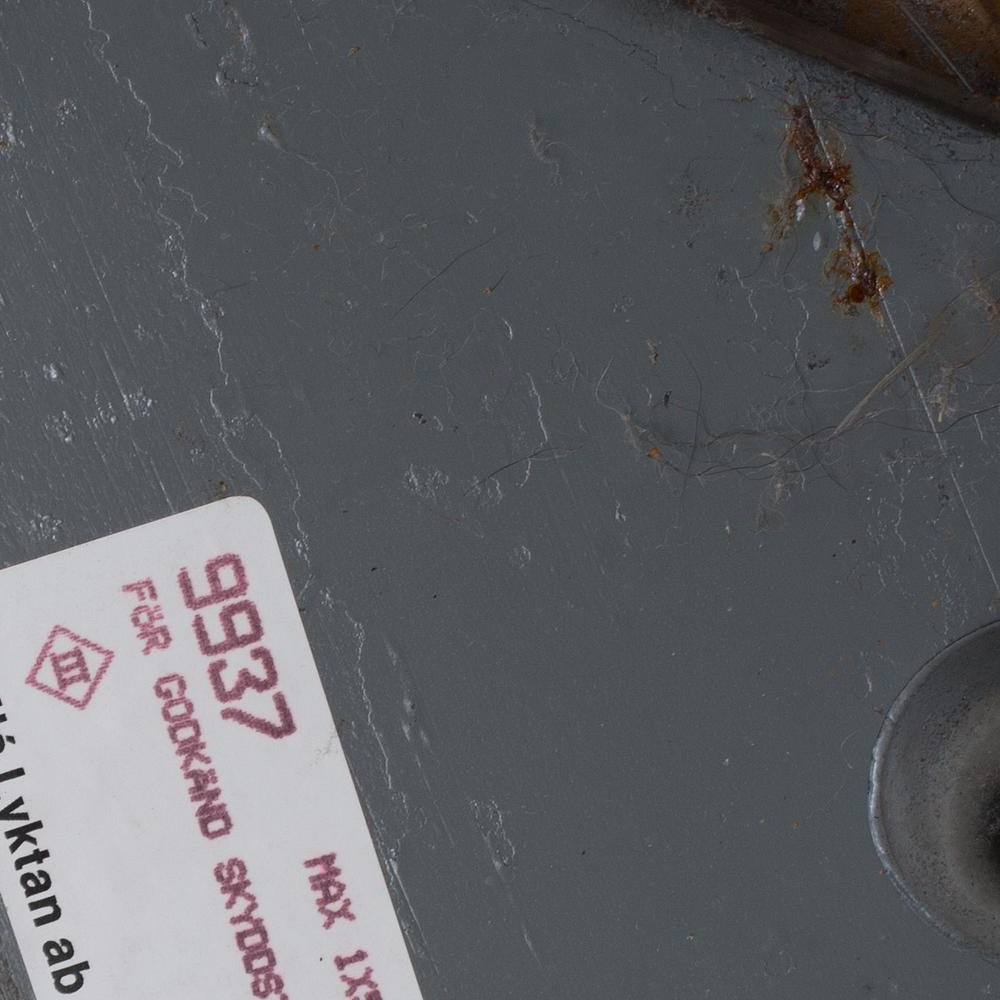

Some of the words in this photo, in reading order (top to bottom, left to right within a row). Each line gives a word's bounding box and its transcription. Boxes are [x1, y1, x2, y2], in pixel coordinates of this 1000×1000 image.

[178, 553, 297, 739] 9937
[154, 674, 233, 840] GODKÄND
[304, 853, 356, 929] MAX
[43, 938, 90, 994] ab
